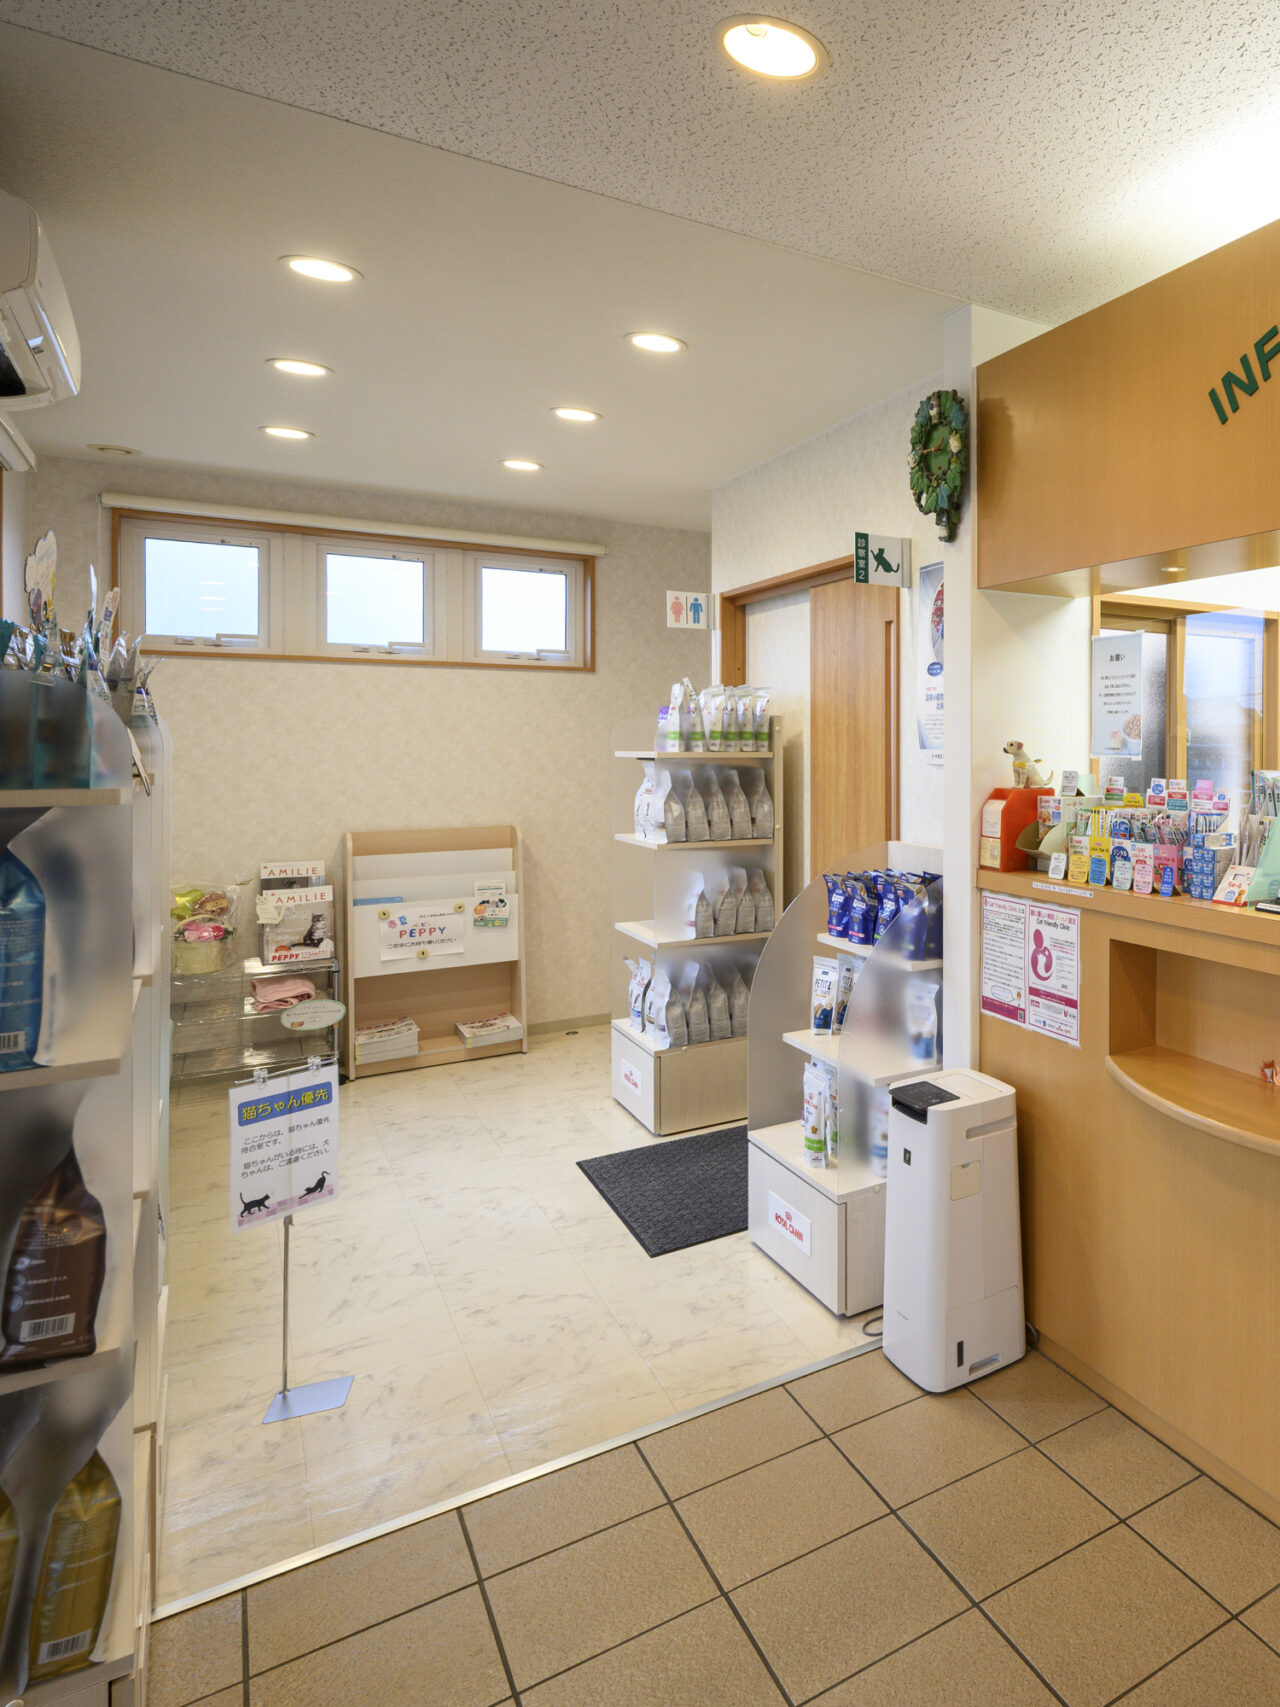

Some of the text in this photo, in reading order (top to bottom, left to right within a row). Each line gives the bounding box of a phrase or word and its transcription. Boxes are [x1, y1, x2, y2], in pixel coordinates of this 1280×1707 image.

[267, 866, 318, 877] AMILIE
[276, 891, 326, 904] AMILIE
[399, 926, 446, 939] PEPPY
[271, 953, 300, 962] PEPPY
[241, 1087, 329, 1121] 猫ちゃん優先
